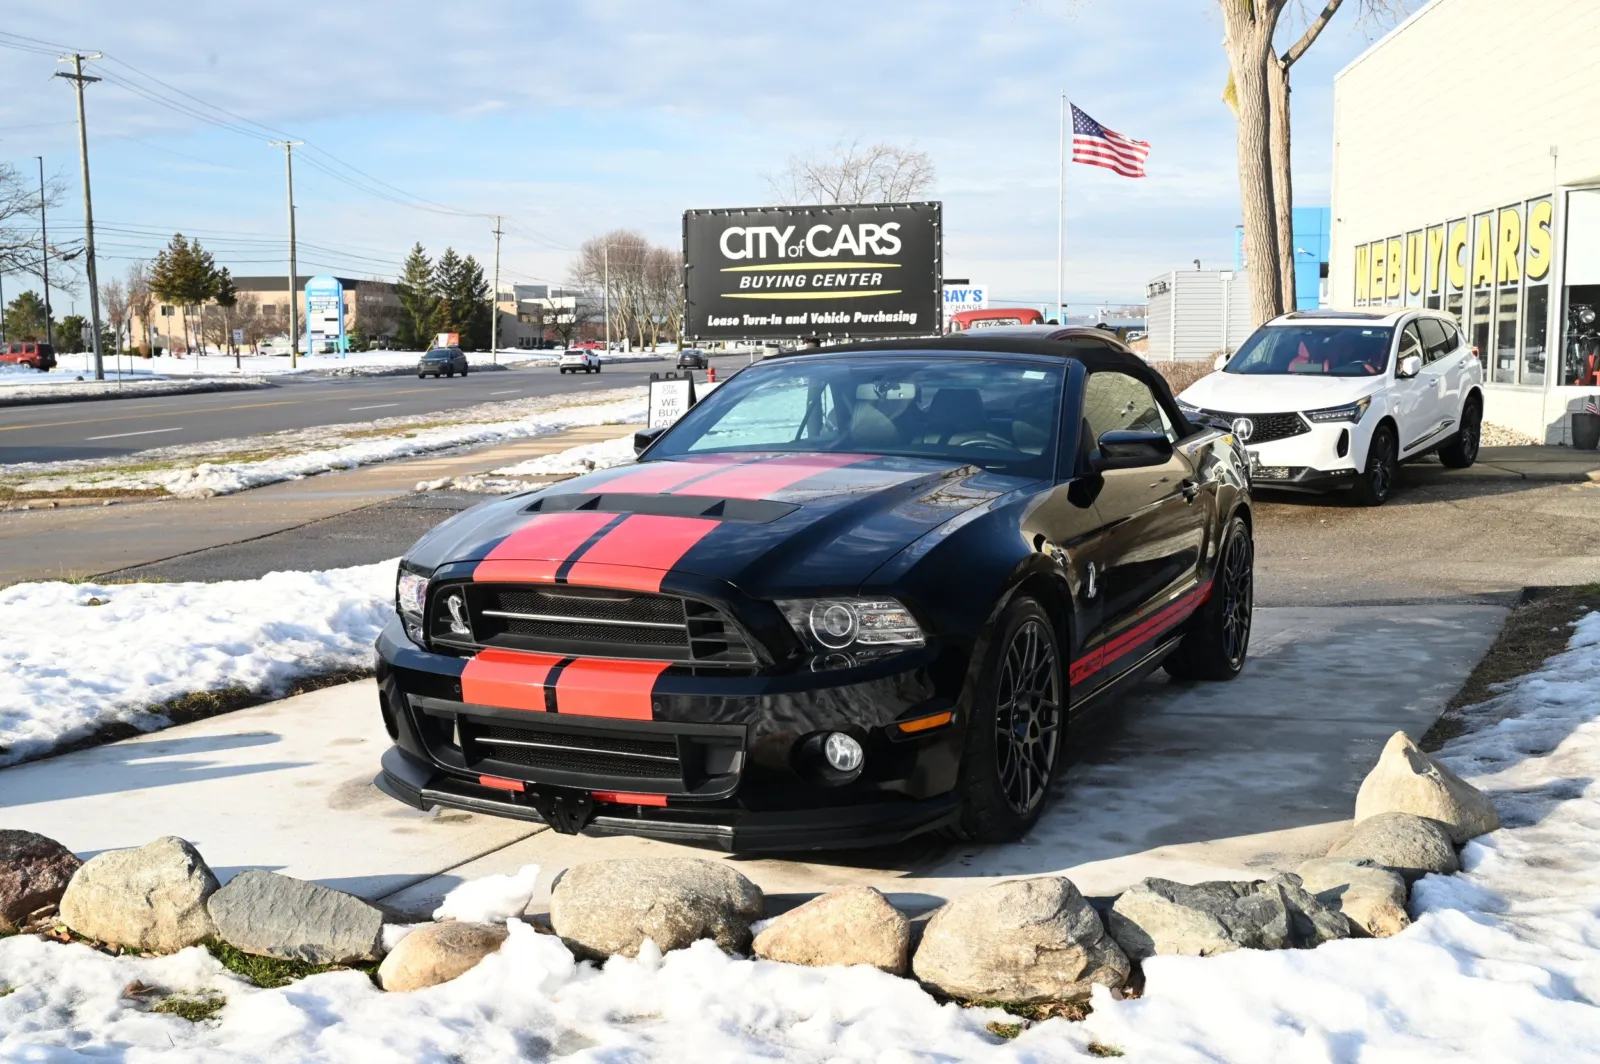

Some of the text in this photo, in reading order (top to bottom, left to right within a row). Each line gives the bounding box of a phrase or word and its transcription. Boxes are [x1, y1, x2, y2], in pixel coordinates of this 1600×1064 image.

[720, 222, 901, 259] CITY of CARS
[739, 273, 882, 288] BUYING CENTER
[708, 310, 917, 326] Lease Turn-In and Vehicle Purchasing
[658, 409, 680, 417] BUY
[654, 420, 676, 428] CAR
